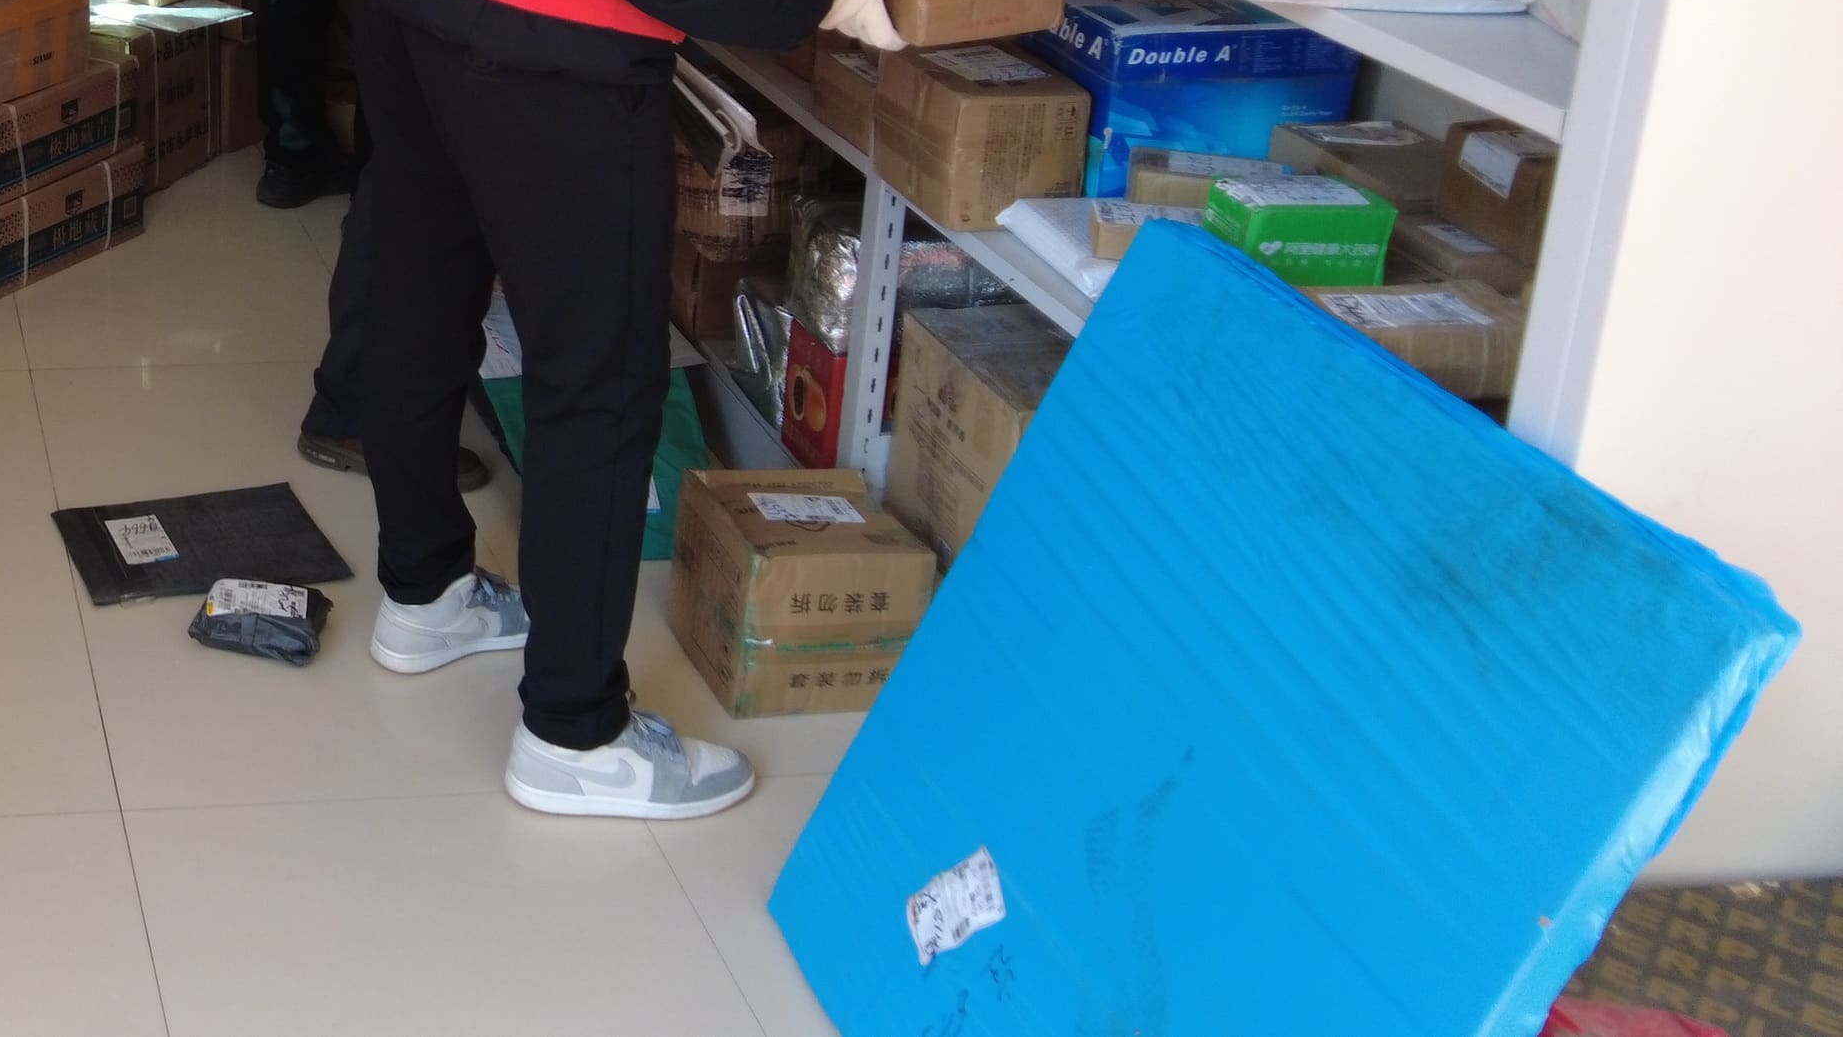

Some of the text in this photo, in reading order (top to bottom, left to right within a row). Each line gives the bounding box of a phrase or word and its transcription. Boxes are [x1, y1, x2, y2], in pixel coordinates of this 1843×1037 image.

[1088, 37, 1103, 60] A
[1128, 45, 1208, 65] Double
[1214, 45, 1232, 62] A
[791, 592, 891, 615] 套装勿拆
